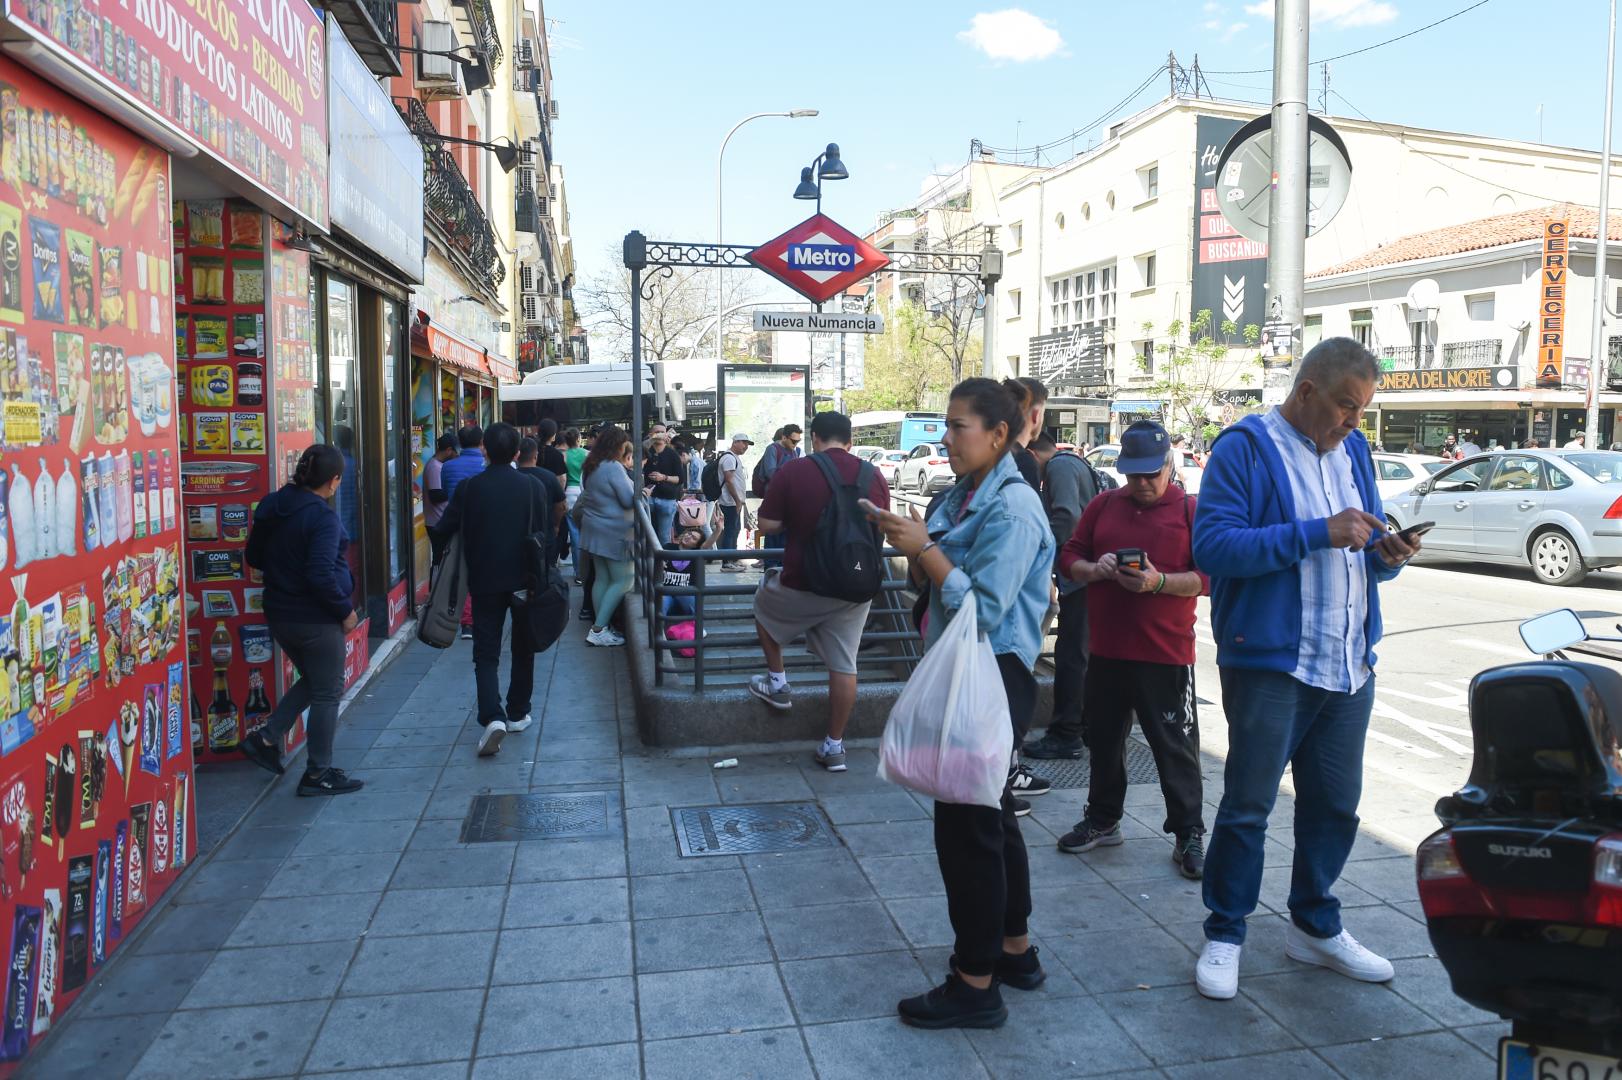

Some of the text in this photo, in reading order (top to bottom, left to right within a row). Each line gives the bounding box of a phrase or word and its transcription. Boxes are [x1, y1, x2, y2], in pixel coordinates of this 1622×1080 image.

[251, 34, 304, 117] BEBIDAS
[240, 72, 294, 150] LATINOS
[33, 242, 57, 264] Doritos
[71, 250, 90, 266] Doritos
[794, 247, 851, 266] Metro
[1541, 222, 1566, 376] CERVECERIA
[762, 314, 876, 330] Nueva Numancia
[1421, 371, 1446, 388] DEL
[1447, 369, 1492, 388] NORTE
[190, 476, 225, 485] SARDINAS
[208, 553, 229, 561] GOYA
[1488, 843, 1552, 859] SUZUKI
[95, 891, 103, 956] OREO
[14, 943, 29, 1029] Dairy Milk
